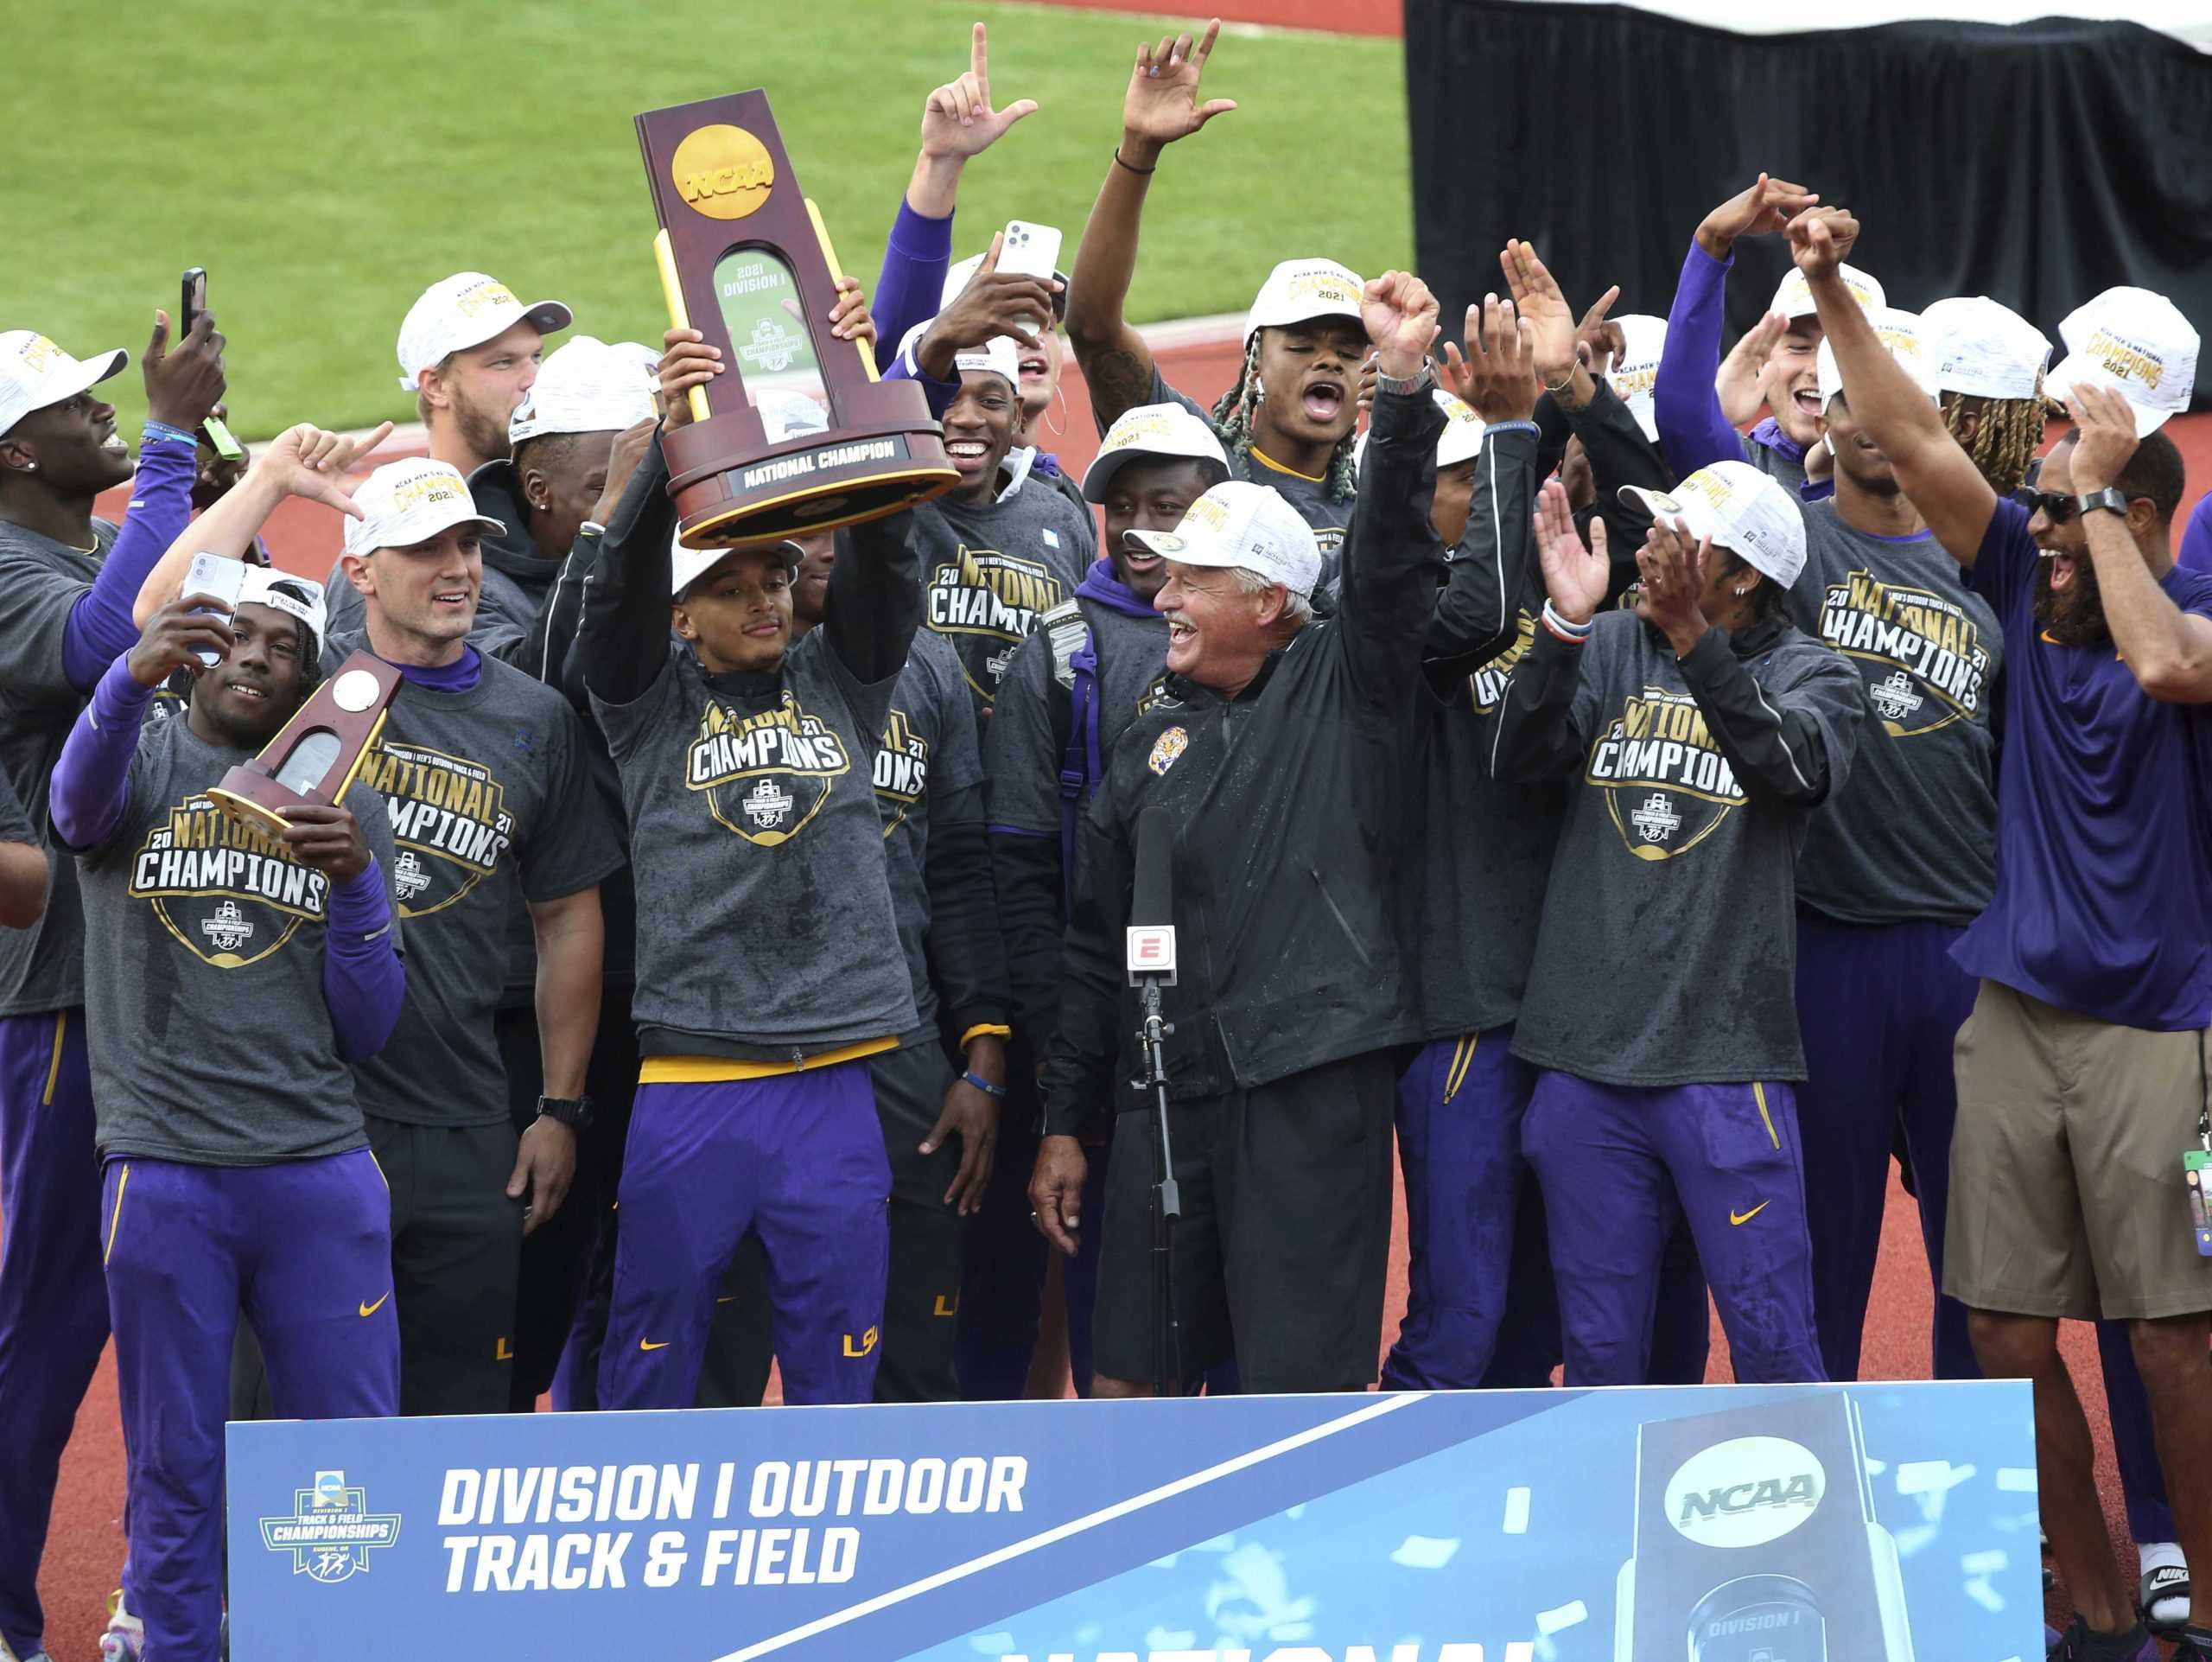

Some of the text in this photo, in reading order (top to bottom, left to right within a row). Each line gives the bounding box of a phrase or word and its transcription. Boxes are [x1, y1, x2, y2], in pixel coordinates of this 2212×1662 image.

[686, 161, 773, 203] NCAA
[737, 264, 764, 279] 2021
[723, 277, 777, 298] DIVISION
[1318, 290, 1344, 302] 2021
[2086, 332, 2164, 391] CHAMPIONS
[2102, 359, 2131, 380] 2021
[745, 441, 895, 489] NATIONAL CHAMPION
[428, 490, 454, 502] 2021
[940, 568, 959, 586] 20
[1827, 589, 1849, 607] 20
[1971, 648, 1987, 672] 21
[801, 719, 820, 736] 21
[908, 739, 924, 760] 21
[388, 796, 509, 867] MPIONS
[495, 812, 512, 834] 21
[151, 831, 172, 850] 20
[135, 848, 325, 913] CHAMPIONS
[1141, 938, 1161, 958] E
[439, 1455, 1028, 1526] DIVISION I OUTDOOR
[1680, 1473, 1816, 1528] NCAA
[297, 1513, 364, 1525] TRACK & FIELD
[273, 1523, 390, 1542] CHAMPIONSHIPS
[444, 1527, 861, 1592] TRACK & FIELD
[1708, 1610, 1801, 1638] DIVISION I
